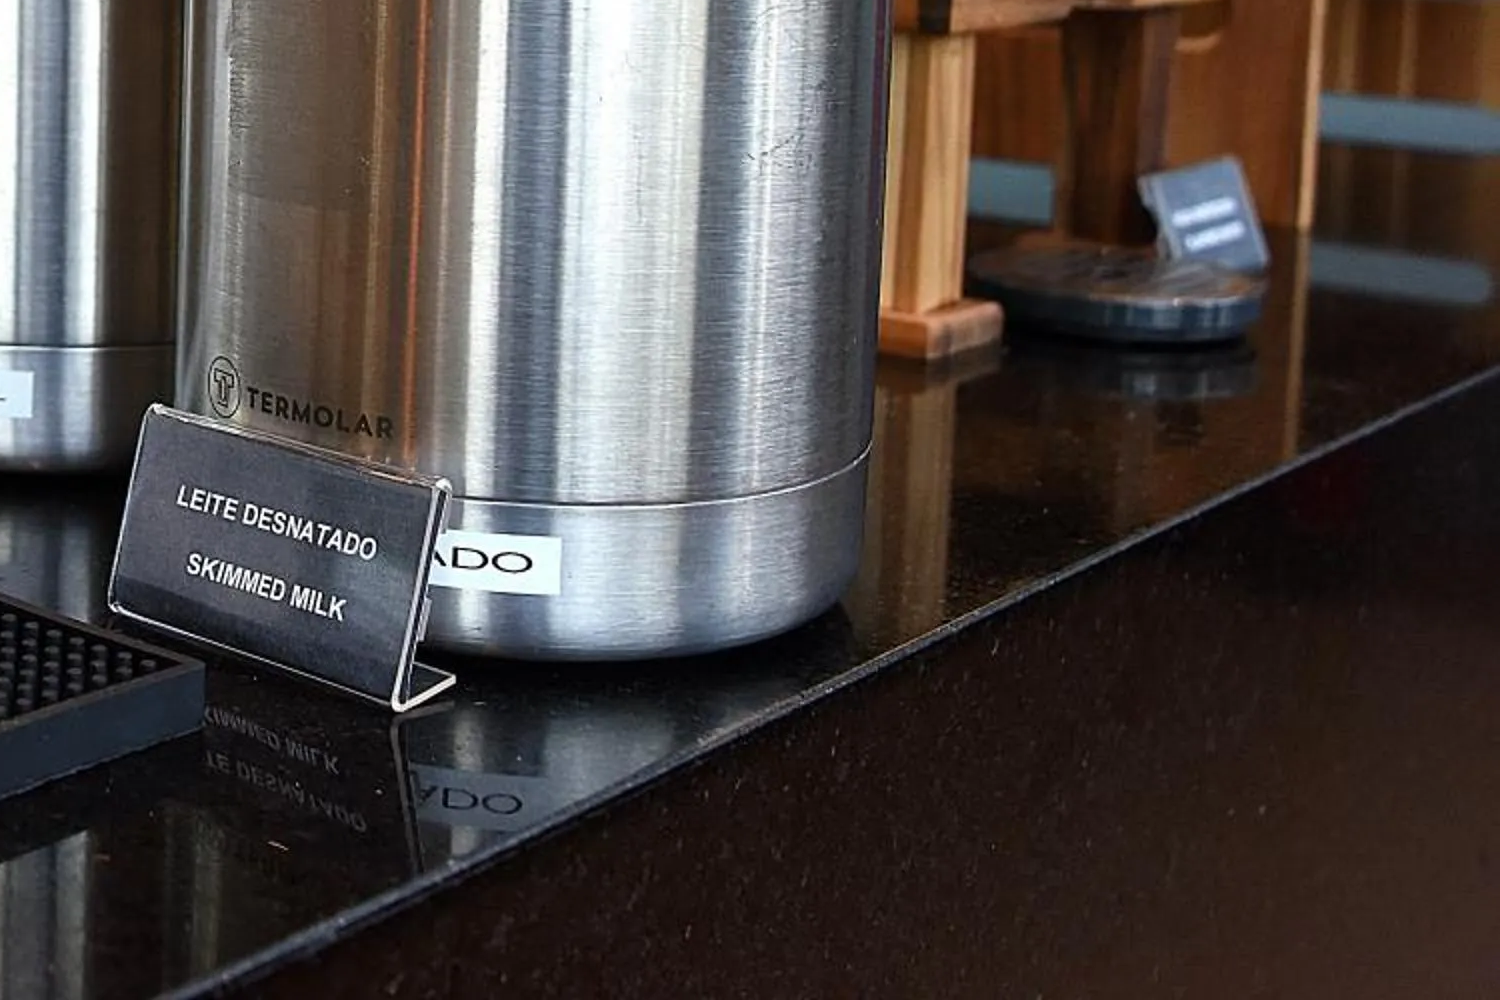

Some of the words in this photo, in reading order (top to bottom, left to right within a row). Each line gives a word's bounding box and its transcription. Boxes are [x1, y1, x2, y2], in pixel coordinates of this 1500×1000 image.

[246, 386, 395, 440] TERMOLAR
[176, 483, 238, 520] LEITE
[242, 503, 379, 562] DESNATADO
[186, 552, 287, 602] SKIMMED
[290, 583, 348, 622] MILK
